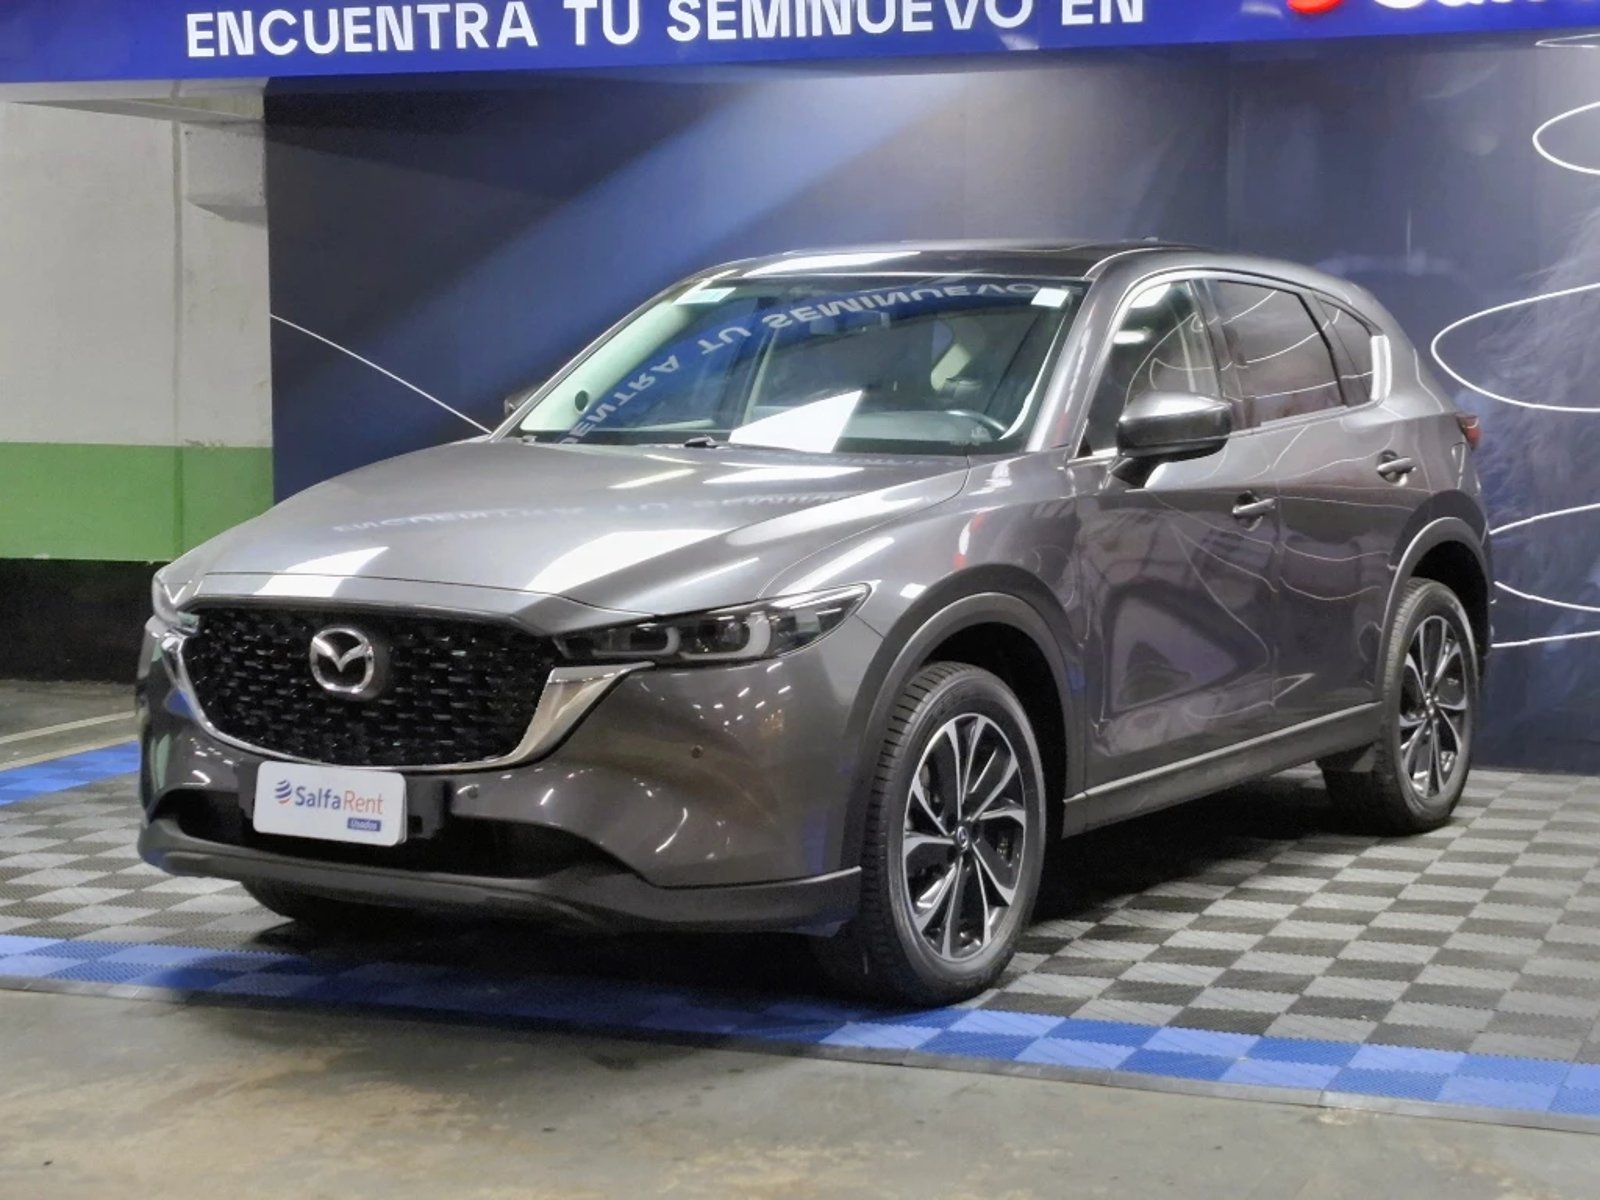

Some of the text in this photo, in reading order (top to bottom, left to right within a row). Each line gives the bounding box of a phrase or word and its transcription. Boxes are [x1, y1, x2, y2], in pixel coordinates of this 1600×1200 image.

[187, 1, 538, 57] ENCUENTRA
[563, 0, 640, 45] TU
[666, 0, 1033, 42] SEMINUEVO
[295, 786, 384, 815] SalfaRent
